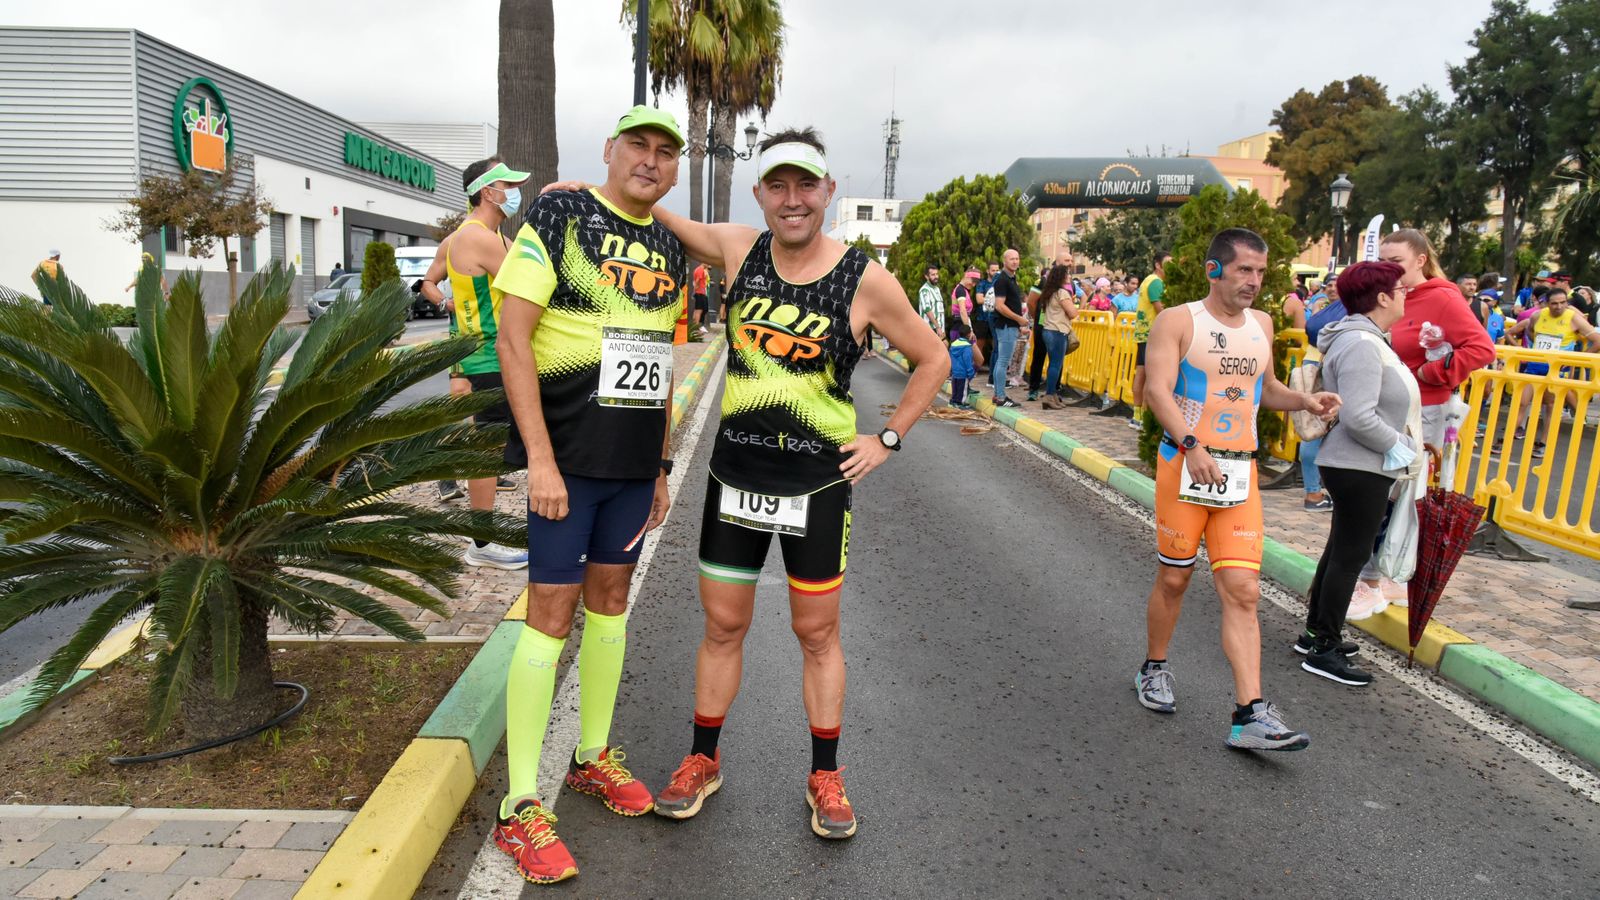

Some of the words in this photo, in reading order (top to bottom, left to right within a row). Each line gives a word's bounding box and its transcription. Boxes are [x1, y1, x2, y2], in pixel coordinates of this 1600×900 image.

[344, 131, 436, 193] MERCADONA
[1067, 182, 1081, 195] BTT
[1085, 180, 1152, 197] ALCORNOCALES
[1157, 174, 1187, 186] ESTRECHO
[1188, 174, 1195, 186] DE
[1159, 185, 1191, 195] GIBRALTAR
[597, 260, 675, 297] STOP
[608, 342, 646, 354] ANTONIO
[647, 344, 671, 355] GONZALO
[732, 324, 821, 362] STOP
[1538, 341, 1552, 350] 179
[614, 360, 660, 391] 226
[1219, 356, 1258, 377] SERGIO
[736, 490, 780, 516] 109
